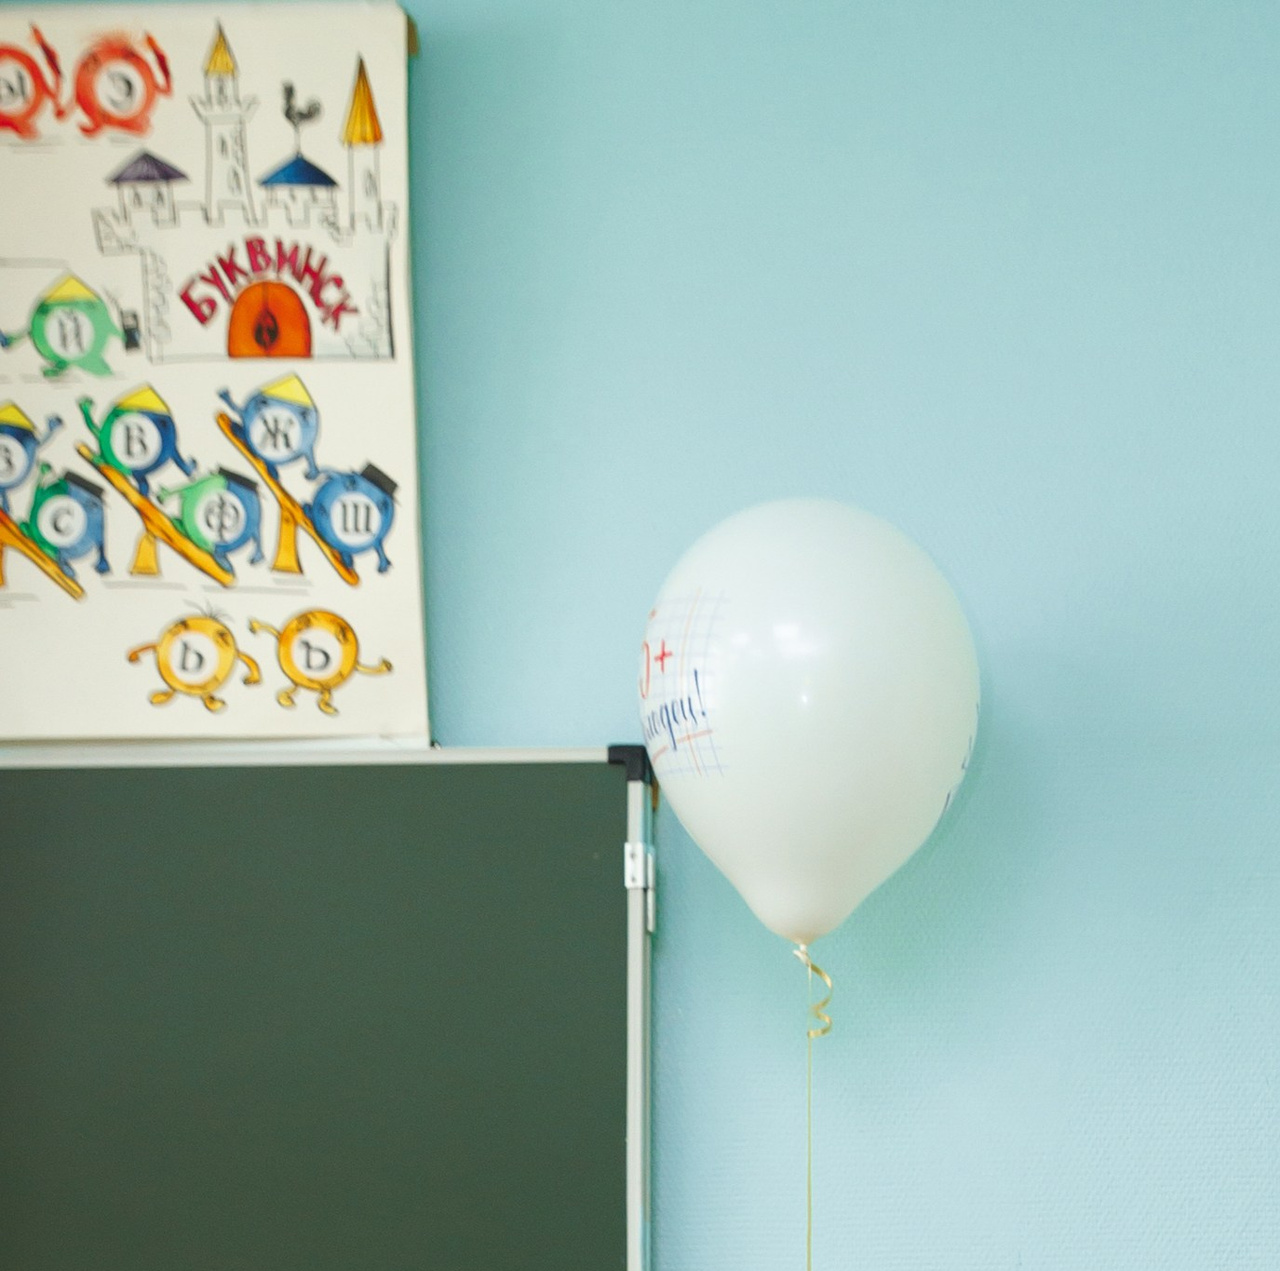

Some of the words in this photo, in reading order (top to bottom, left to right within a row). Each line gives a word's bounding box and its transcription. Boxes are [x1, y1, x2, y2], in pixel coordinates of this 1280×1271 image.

[178, 234, 359, 333] БУКВИНСК
[124, 425, 149, 458] В
[258, 415, 296, 451] Ж
[203, 495, 241, 543] Ф
[340, 502, 373, 534] Ш
